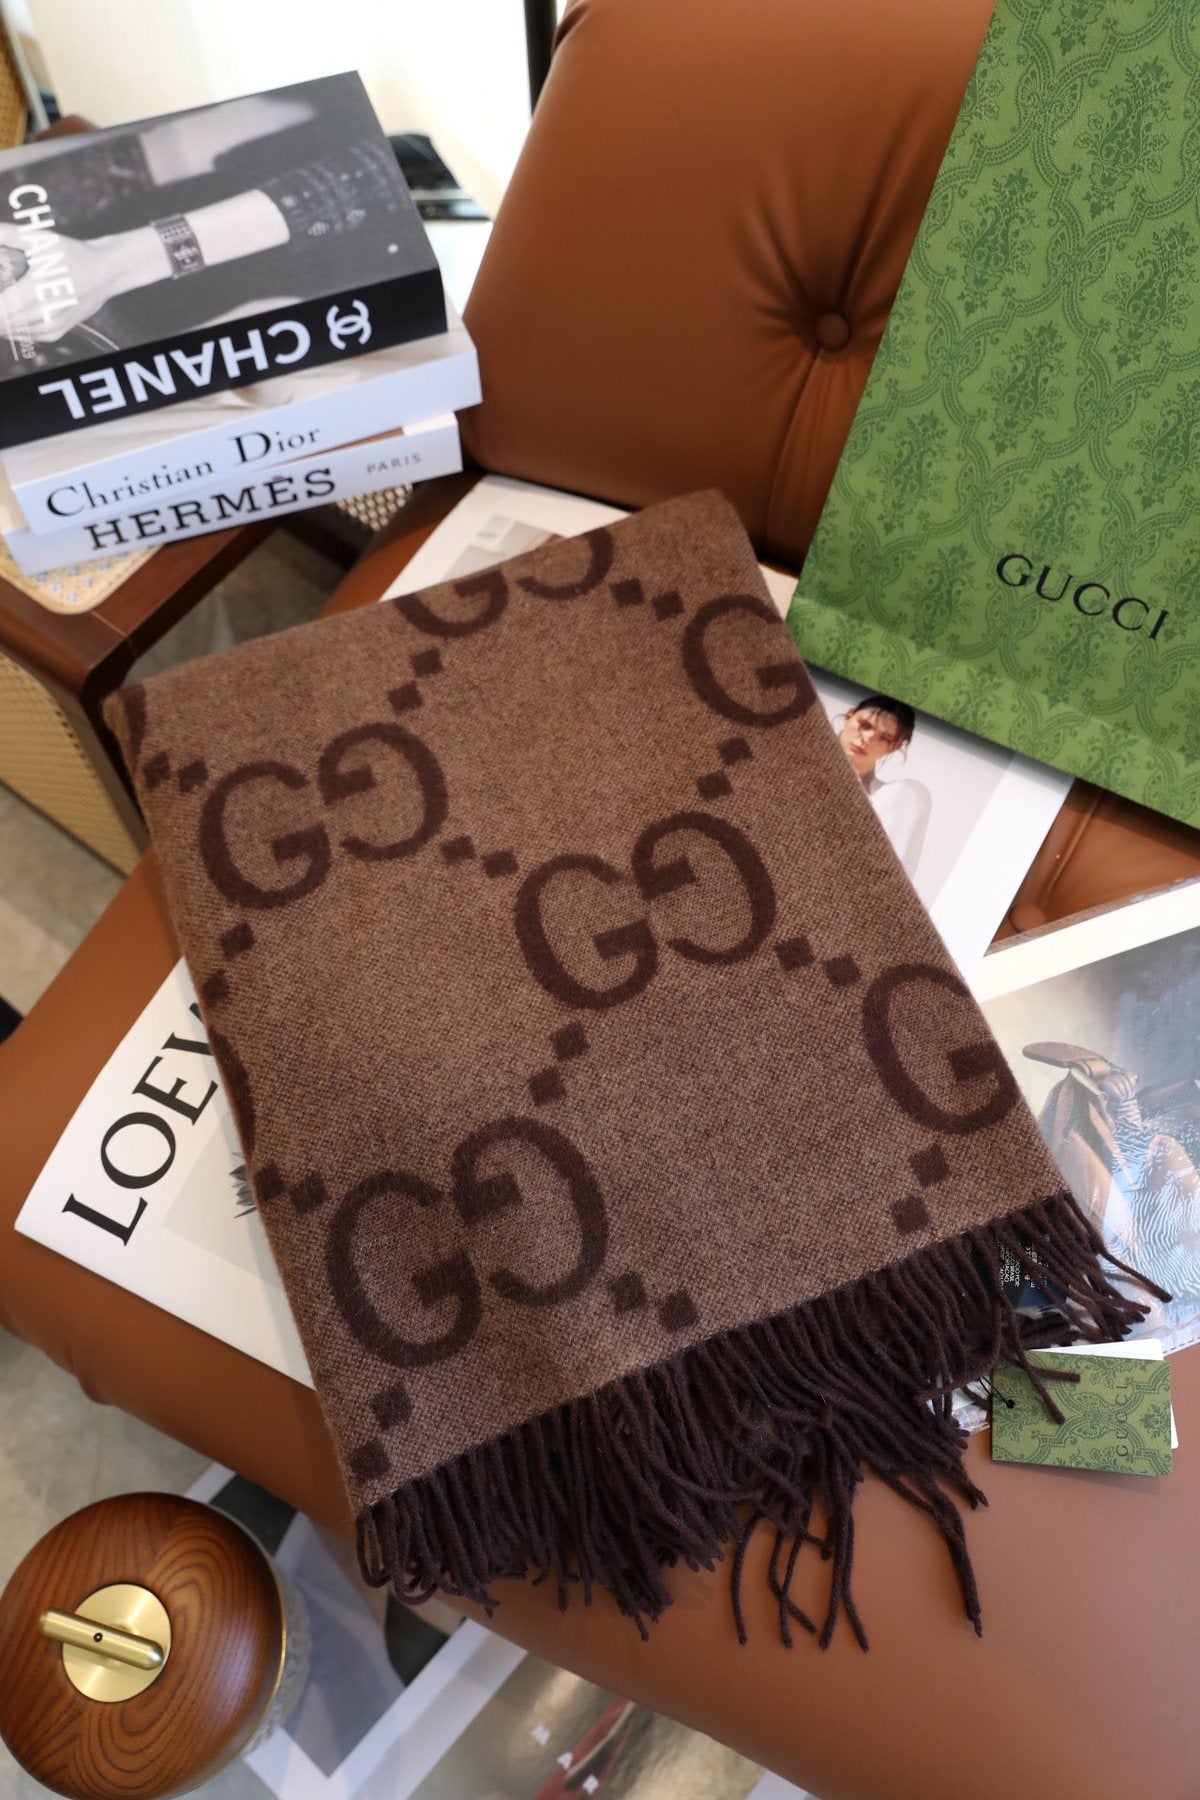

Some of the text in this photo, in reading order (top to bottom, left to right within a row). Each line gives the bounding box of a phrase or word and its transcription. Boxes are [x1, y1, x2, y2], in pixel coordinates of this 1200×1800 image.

[8, 184, 79, 323] CHANEL
[38, 320, 310, 419] CHANEL
[46, 428, 321, 518] Christian Dior
[366, 453, 422, 475] PARIS
[996, 553, 1170, 640] GUCCI
[1115, 1385, 1128, 1457] GUCCI
